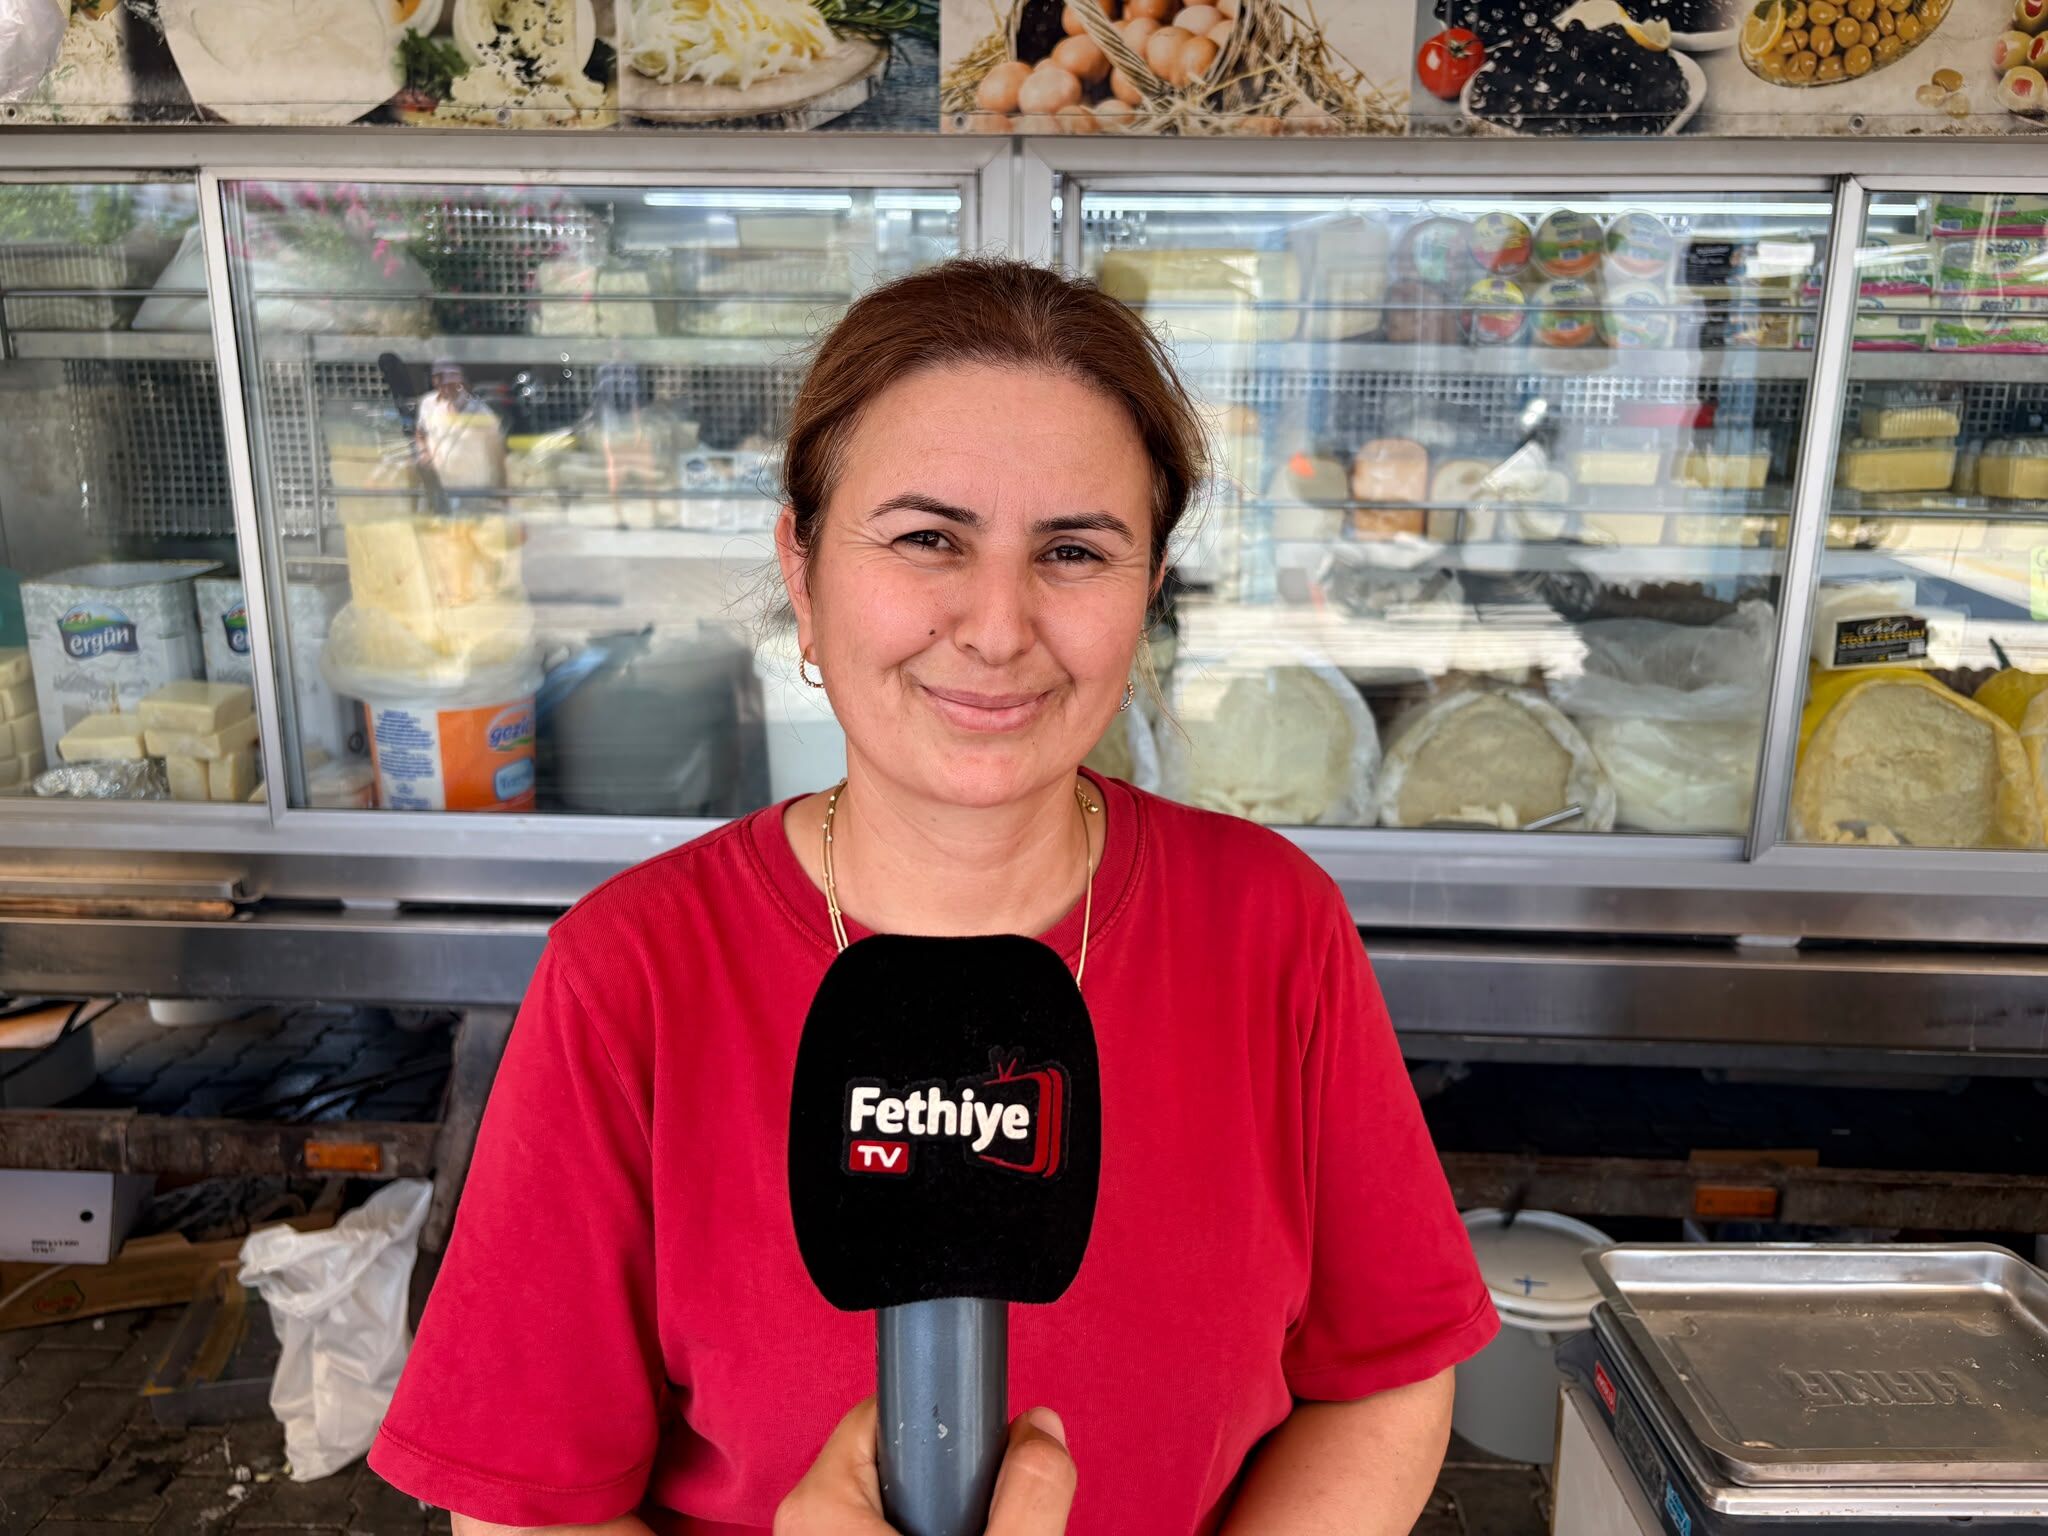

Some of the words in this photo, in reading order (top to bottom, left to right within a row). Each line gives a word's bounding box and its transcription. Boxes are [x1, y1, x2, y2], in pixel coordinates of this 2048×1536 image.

[70, 626, 130, 656] ergün
[850, 1086, 1030, 1153] Fethiye
[857, 1144, 903, 1168] TV
